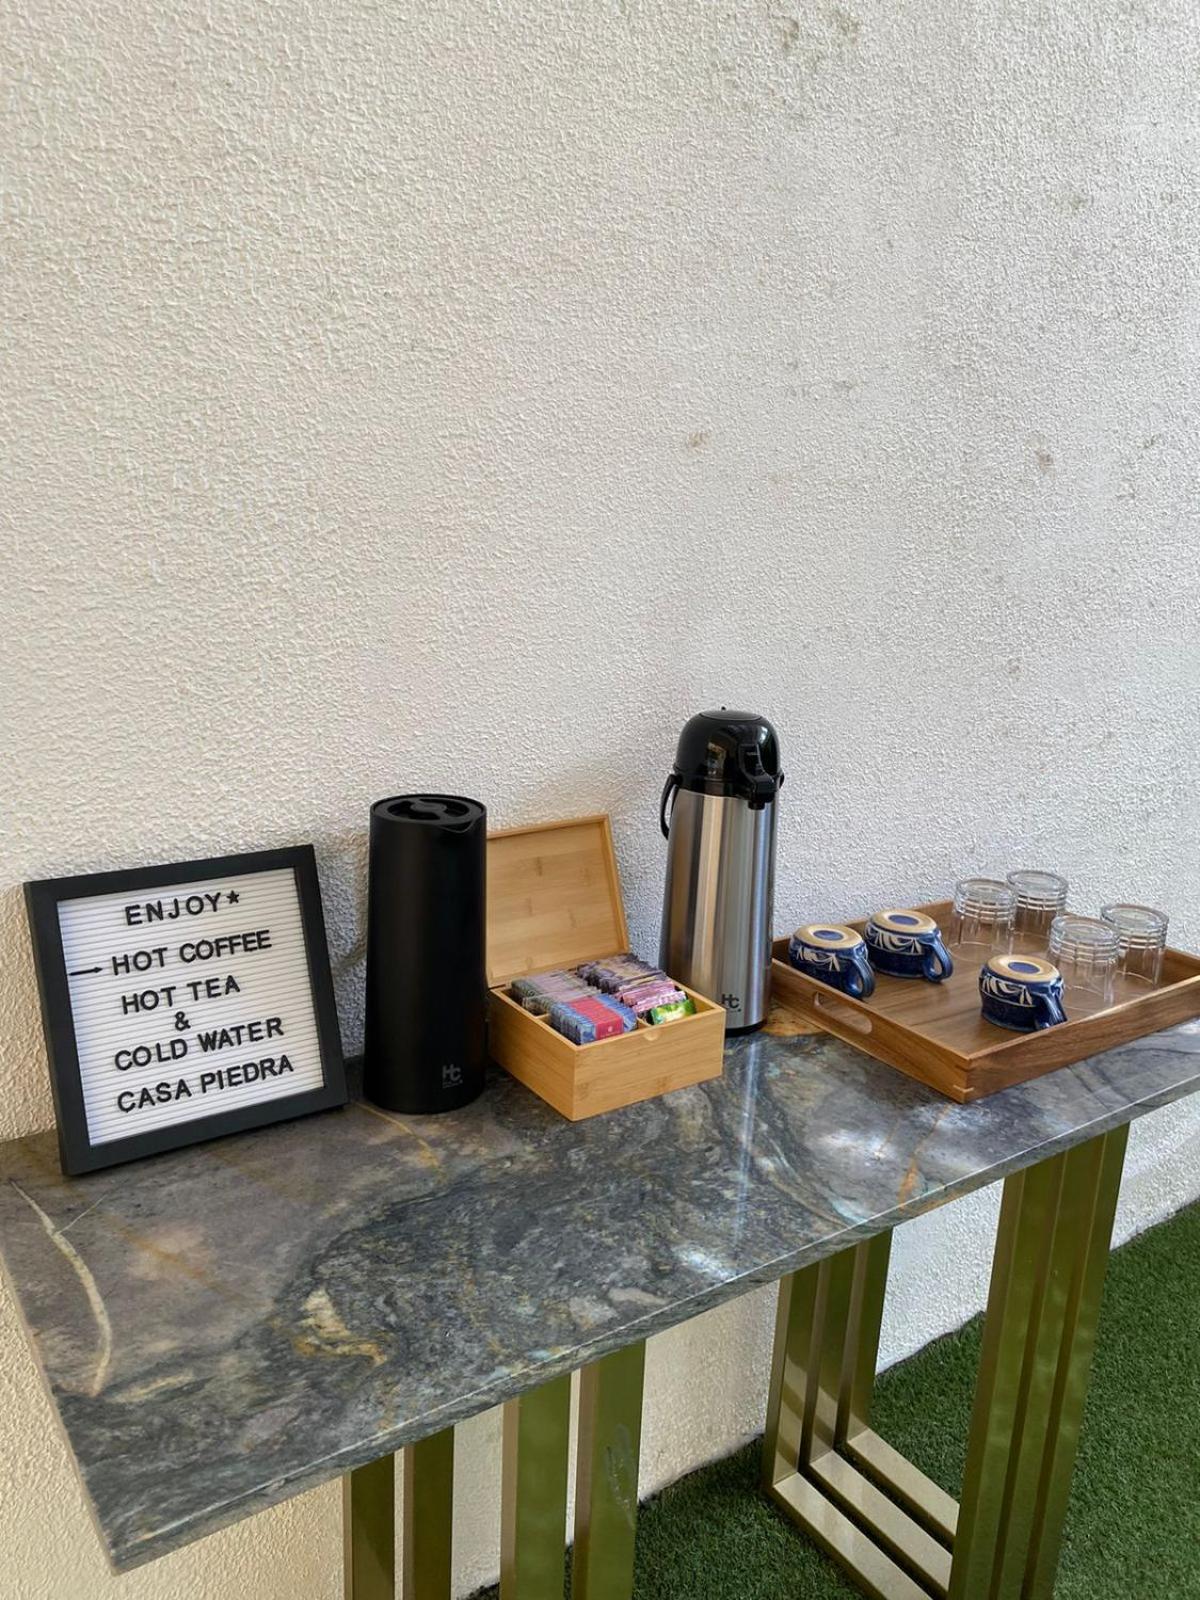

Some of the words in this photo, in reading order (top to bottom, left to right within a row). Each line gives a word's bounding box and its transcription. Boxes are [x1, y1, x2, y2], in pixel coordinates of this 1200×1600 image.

[125, 892, 221, 926] ENJOY
[111, 947, 168, 976] HOT
[179, 930, 273, 963] COFFEE
[121, 986, 176, 1015] HOT
[187, 975, 241, 1002] TEA
[174, 1011, 191, 1032] &
[114, 1038, 188, 1071] COLD
[197, 1017, 284, 1052] WATER
[117, 1078, 192, 1113] CASA
[200, 1055, 294, 1093] PIEDRA
